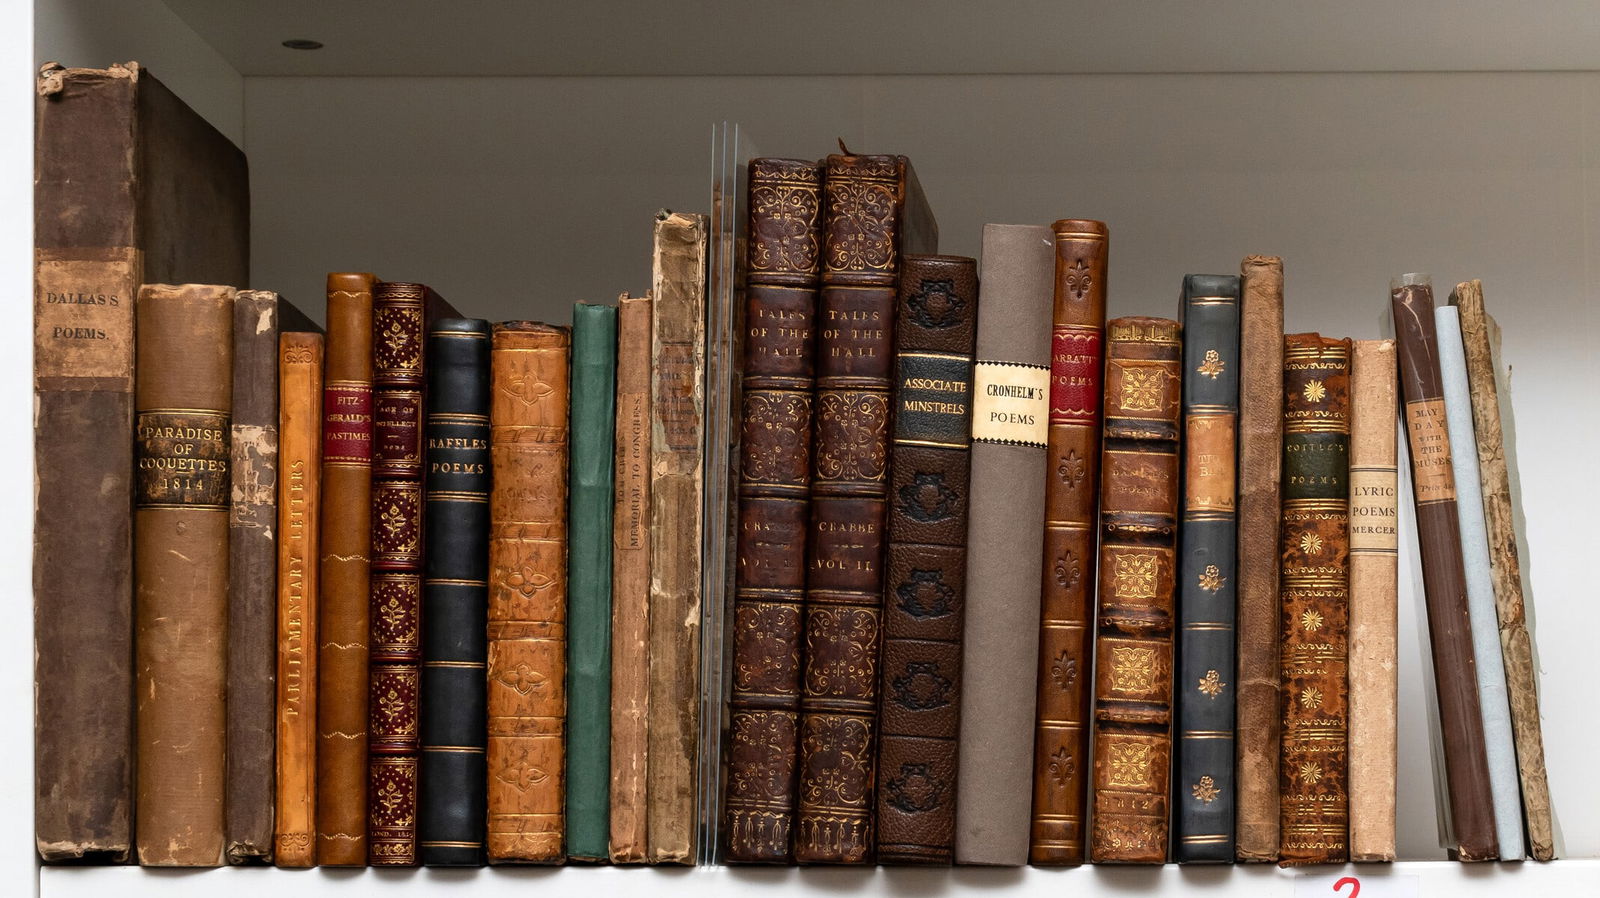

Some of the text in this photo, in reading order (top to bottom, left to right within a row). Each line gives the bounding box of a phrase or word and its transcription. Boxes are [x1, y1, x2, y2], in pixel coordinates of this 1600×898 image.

[46, 292, 120, 307] DALLAS'S
[828, 310, 880, 321] TALES
[52, 326, 110, 341] POEMS.
[750, 327, 809, 339] OF THE
[823, 329, 883, 340] OF THE
[831, 347, 877, 358] HALL
[903, 377, 967, 393] ASSOCIATE
[986, 383, 1044, 401] CRONHELM'S
[903, 400, 965, 415] MINSTRELS
[1415, 408, 1439, 418] MAY
[327, 413, 372, 423] GERALD'S
[989, 411, 1036, 426] POEMS
[1414, 420, 1445, 431] DAY
[145, 426, 223, 442] PARADISE
[326, 431, 371, 441] PASTIMES
[1418, 434, 1442, 442] WITH
[173, 443, 195, 455] OF
[429, 437, 487, 450] RAFFLES
[1420, 445, 1443, 455] THE
[139, 456, 227, 473] COQUETTES
[1415, 456, 1452, 468] MUSES
[431, 462, 485, 475] POEMS
[631, 465, 641, 479] TO
[162, 478, 204, 491] 1814
[1290, 475, 1338, 485] POEMS
[1354, 486, 1394, 498] LYRIC
[630, 484, 641, 548] MEMORIAL
[1352, 506, 1396, 518] POEMS
[818, 521, 876, 534] CRABBE
[1351, 525, 1396, 535] MERCER
[286, 459, 305, 717] PARLIAMENTARY LETTERS
